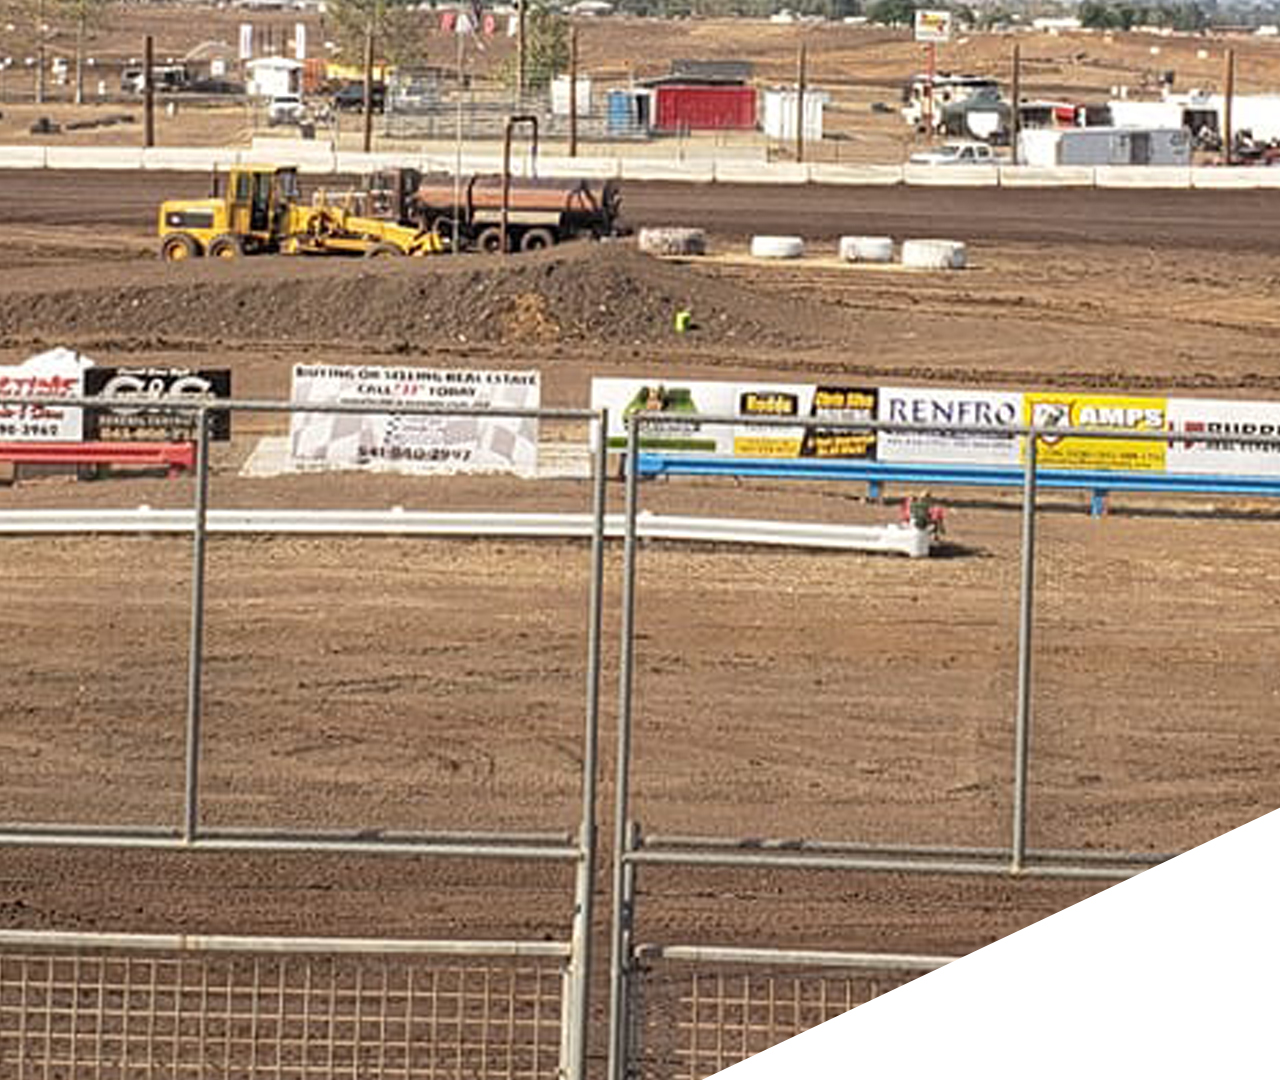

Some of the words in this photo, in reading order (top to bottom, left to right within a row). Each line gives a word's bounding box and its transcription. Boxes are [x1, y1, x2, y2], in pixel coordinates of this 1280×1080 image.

[295, 366, 355, 380] BUYING
[358, 368, 380, 380] OR
[445, 371, 482, 384] REAL
[486, 373, 537, 385] ESTATE
[357, 384, 391, 395] CALL
[428, 387, 477, 397] TODAY
[889, 398, 1016, 425] RENFRO
[1079, 407, 1165, 428] AMPS
